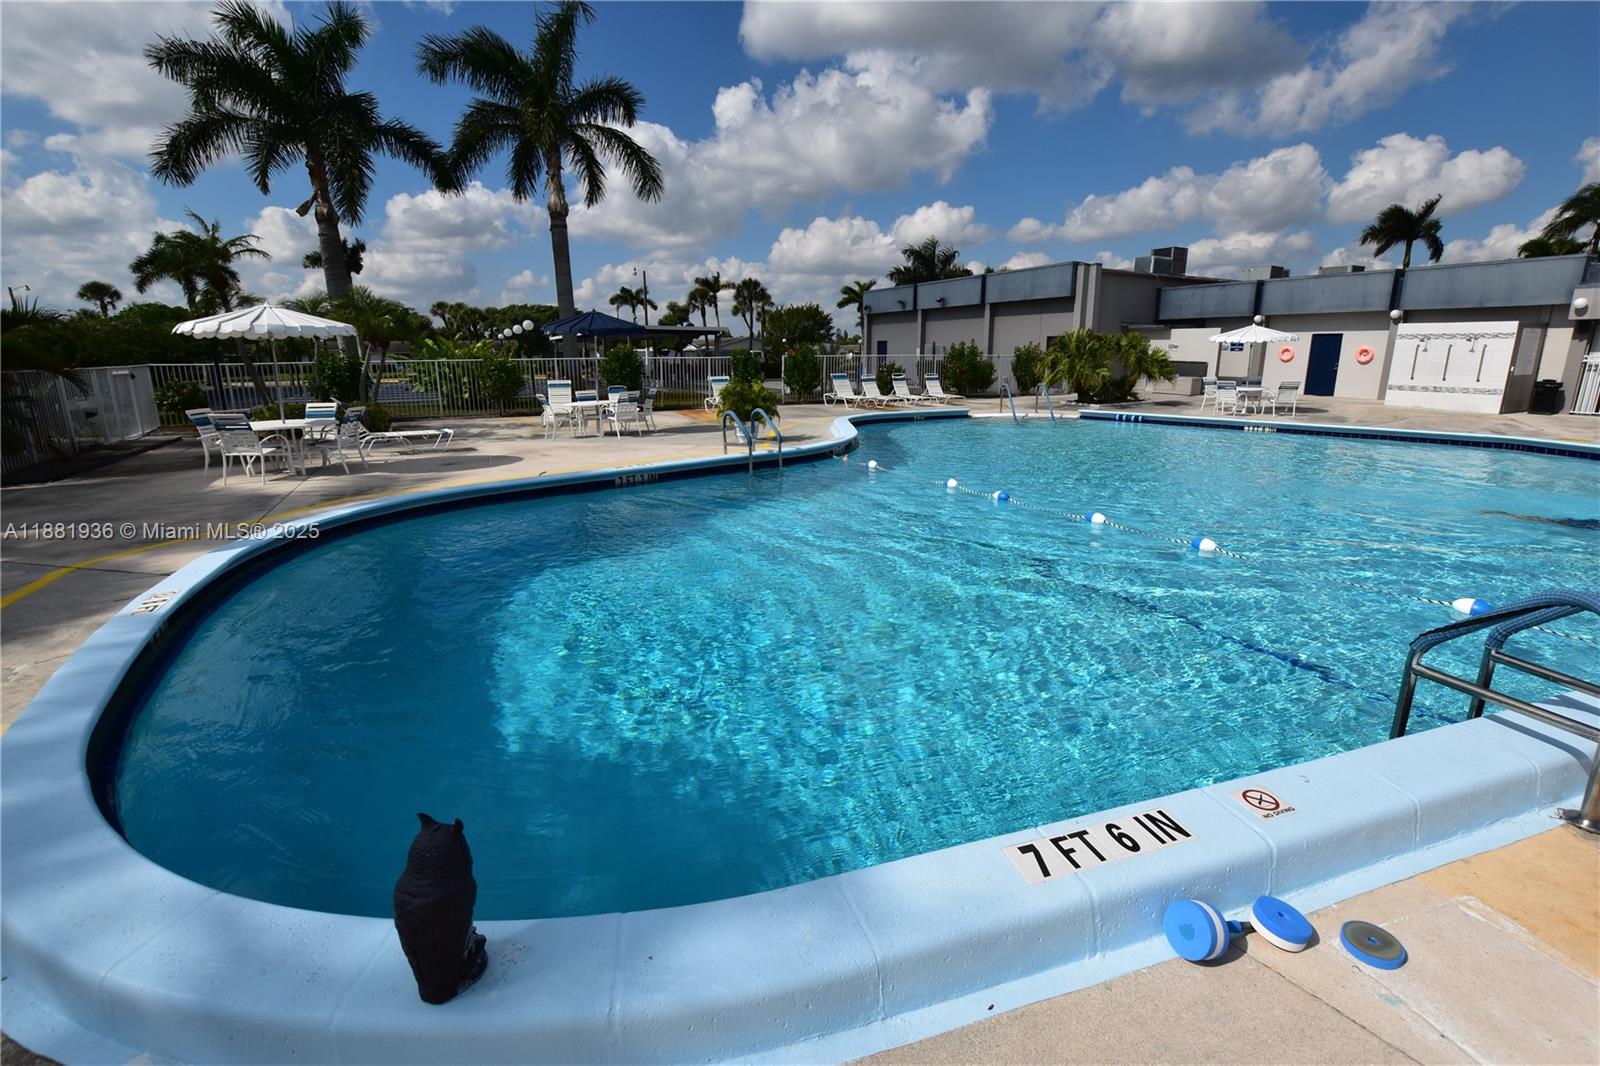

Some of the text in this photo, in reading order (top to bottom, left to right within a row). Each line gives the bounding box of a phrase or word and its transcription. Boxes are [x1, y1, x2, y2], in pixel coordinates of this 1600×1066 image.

[1273, 806, 1296, 816] DIVING
[1017, 810, 1192, 878] 7 FT 6 IN
